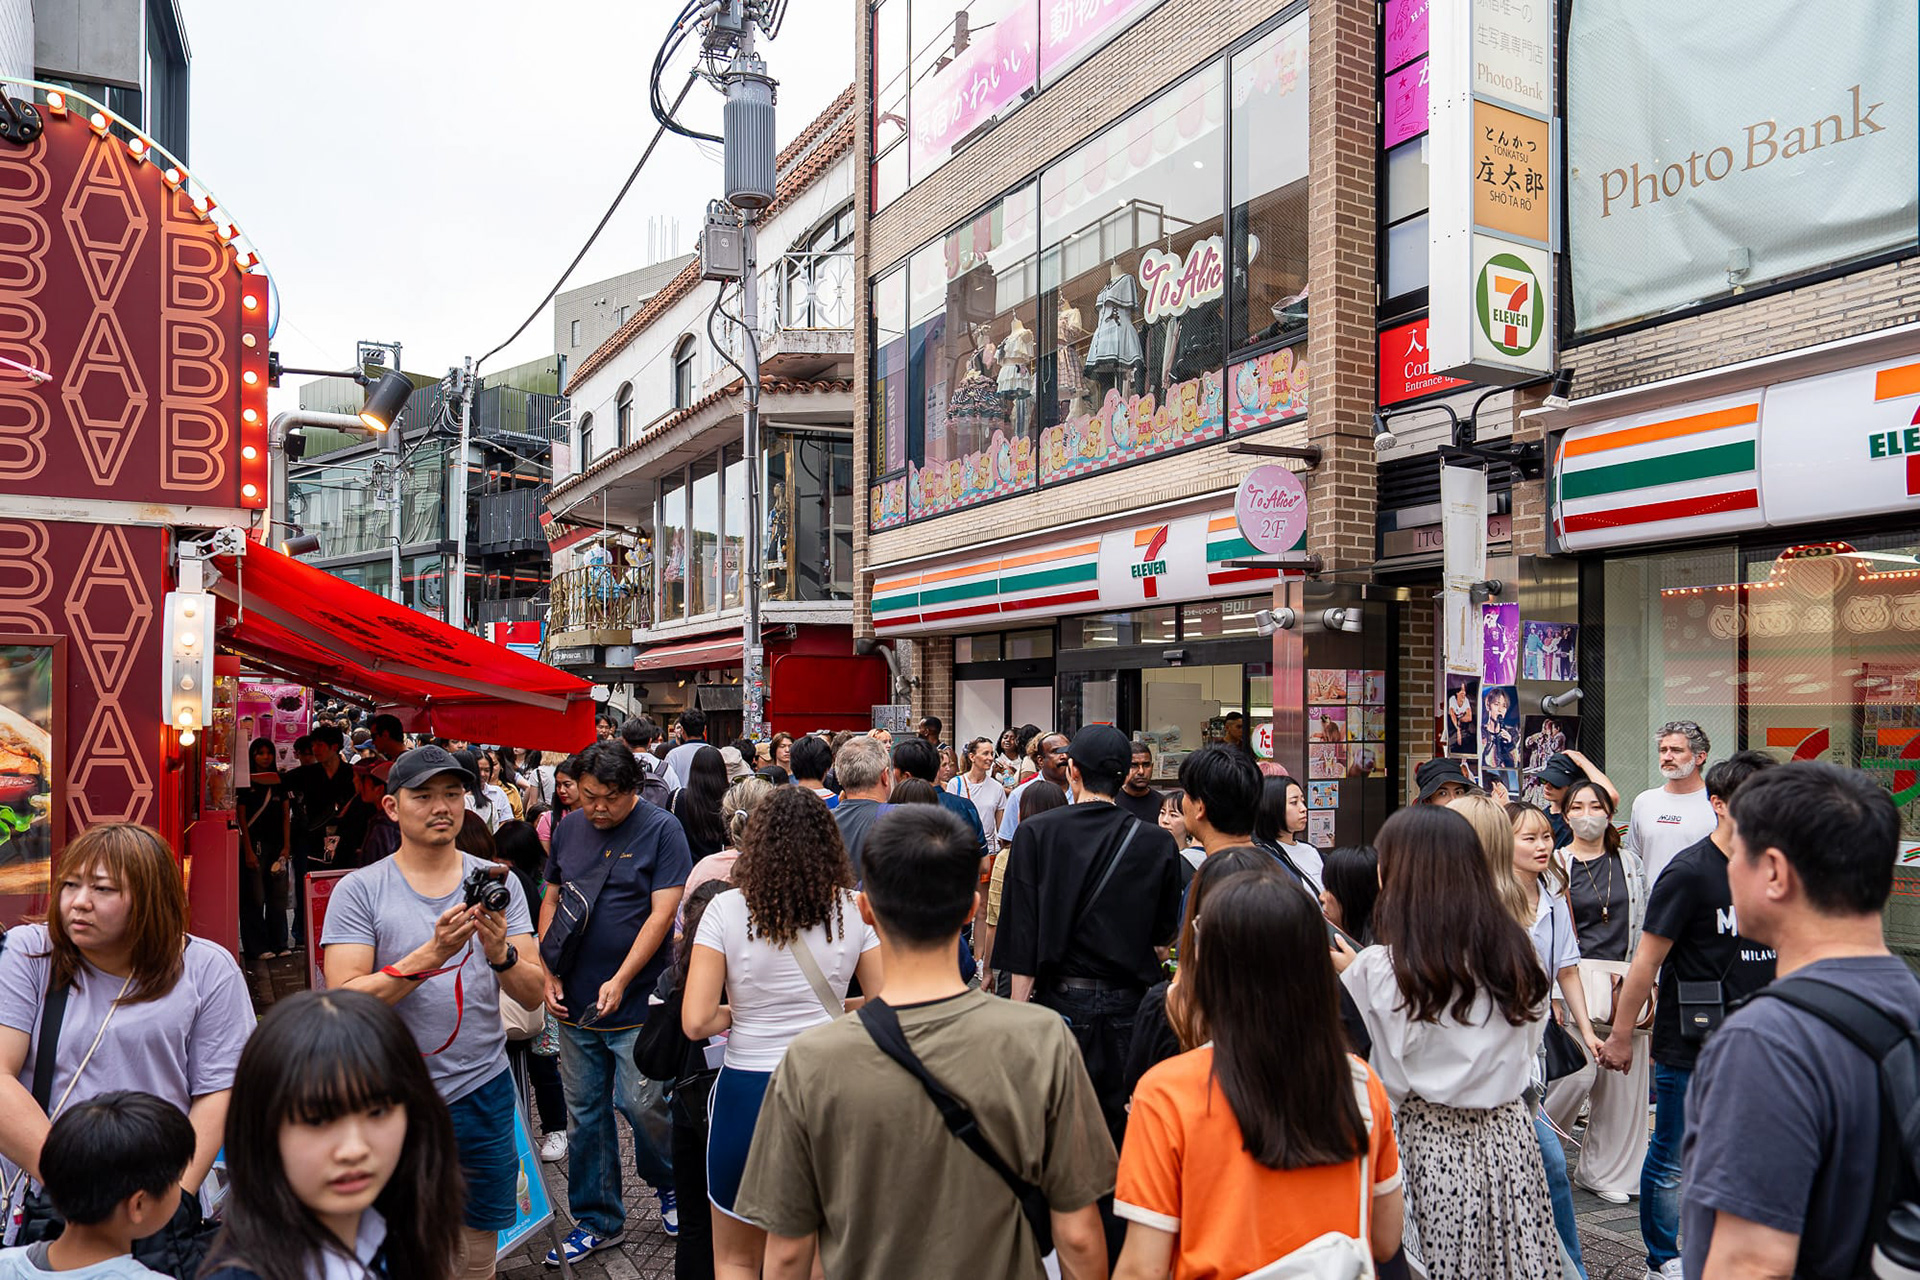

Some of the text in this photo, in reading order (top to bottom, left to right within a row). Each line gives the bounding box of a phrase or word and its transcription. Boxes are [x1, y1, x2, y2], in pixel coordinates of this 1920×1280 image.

[1477, 22, 1544, 65] 生写真専門店
[1477, 62, 1543, 101] Photo Bank
[1485, 126, 1537, 152] とんかつ
[1599, 84, 1886, 219] Photo Bank
[1493, 145, 1529, 164] TONKATSU
[1476, 155, 1545, 200] 庄太郎
[1142, 246, 1223, 315] To Alic
[1405, 374, 1443, 392] Entrance
[1248, 484, 1295, 509] To Alice
[1261, 519, 1286, 539] 2F
[1260, 728, 1273, 748] た
